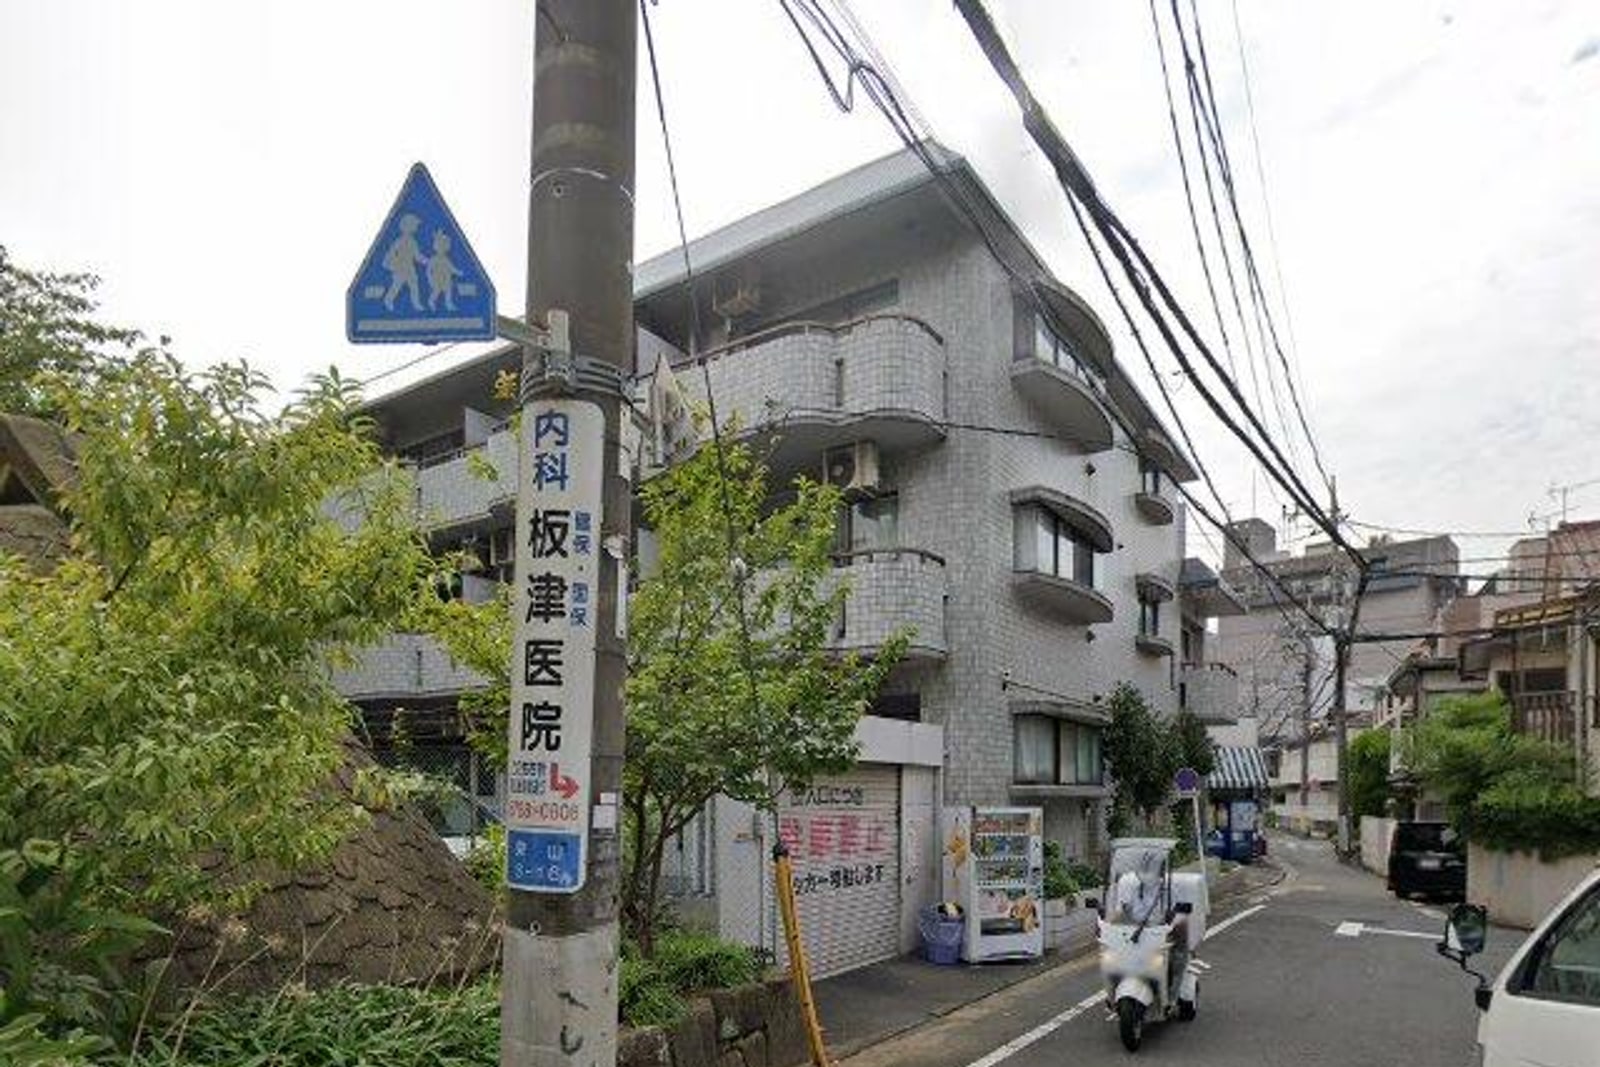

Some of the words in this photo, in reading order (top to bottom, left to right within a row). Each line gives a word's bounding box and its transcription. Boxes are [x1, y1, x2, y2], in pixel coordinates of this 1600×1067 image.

[533, 409, 569, 491] 内科
[521, 508, 570, 751] 板津医院
